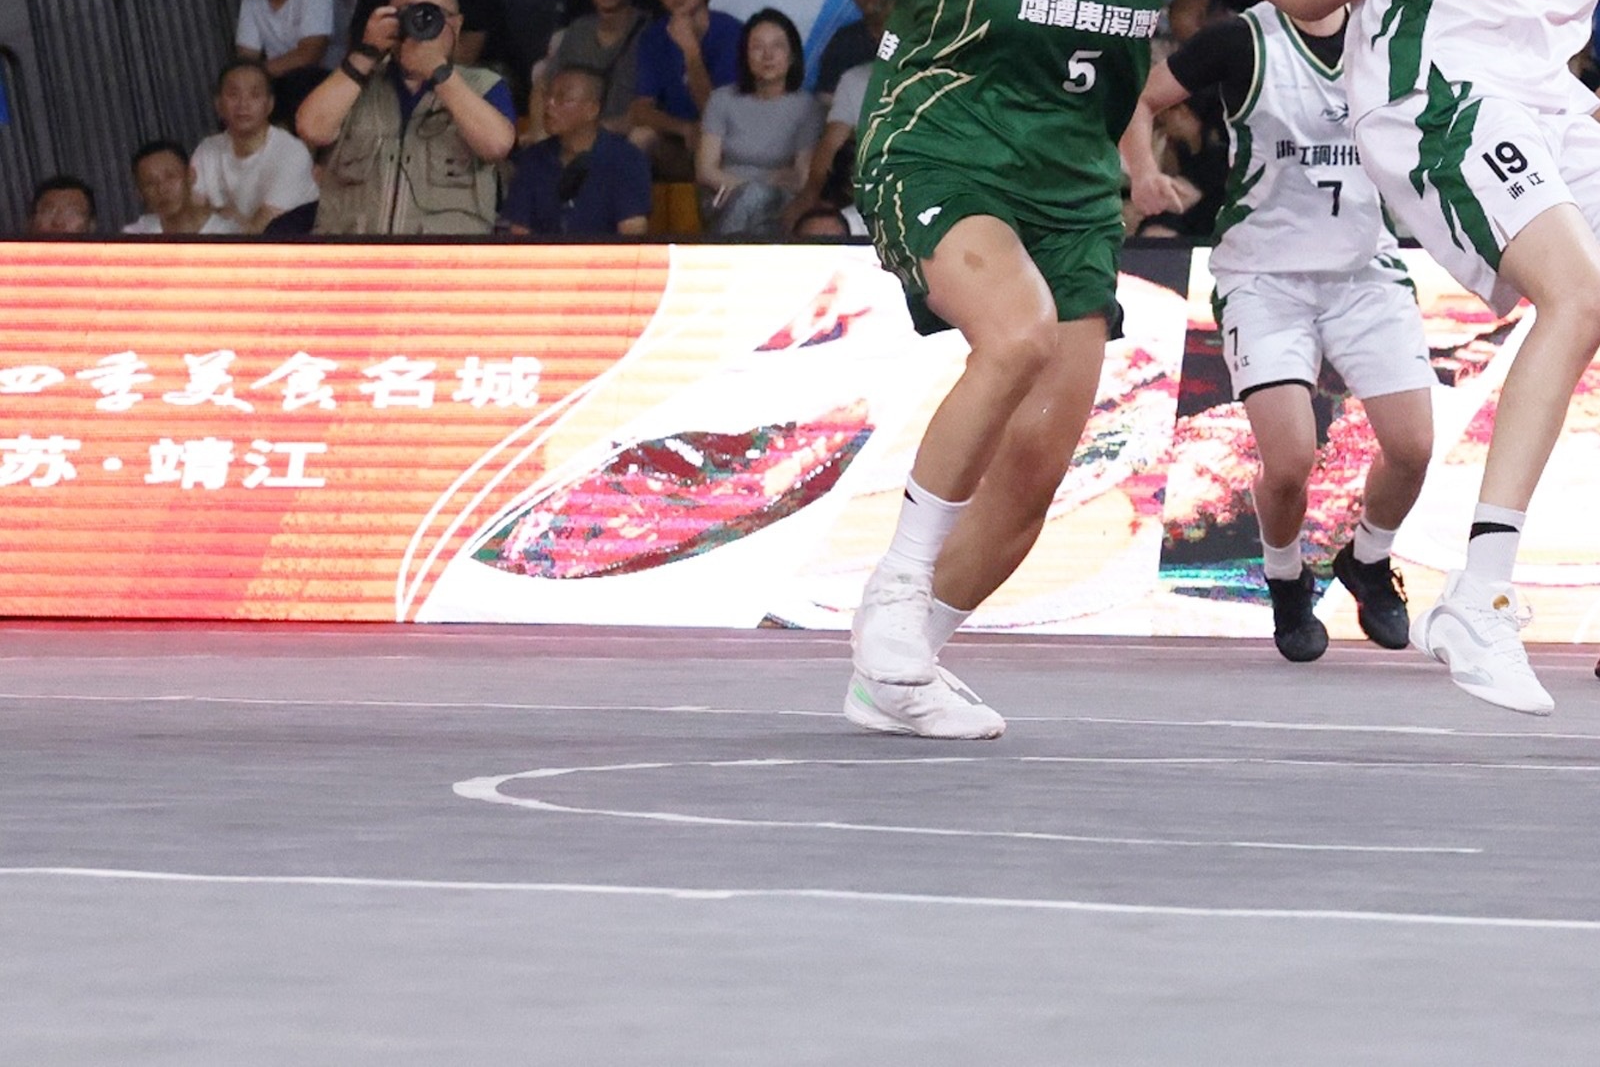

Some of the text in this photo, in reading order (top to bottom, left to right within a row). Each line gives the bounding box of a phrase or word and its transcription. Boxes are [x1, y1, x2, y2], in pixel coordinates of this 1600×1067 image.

[1062, 49, 1103, 94] 5
[1276, 139, 1362, 166] 浙江稠州
[1481, 141, 1528, 183] 19
[1317, 180, 1342, 217] 7
[1228, 326, 1239, 356] 7
